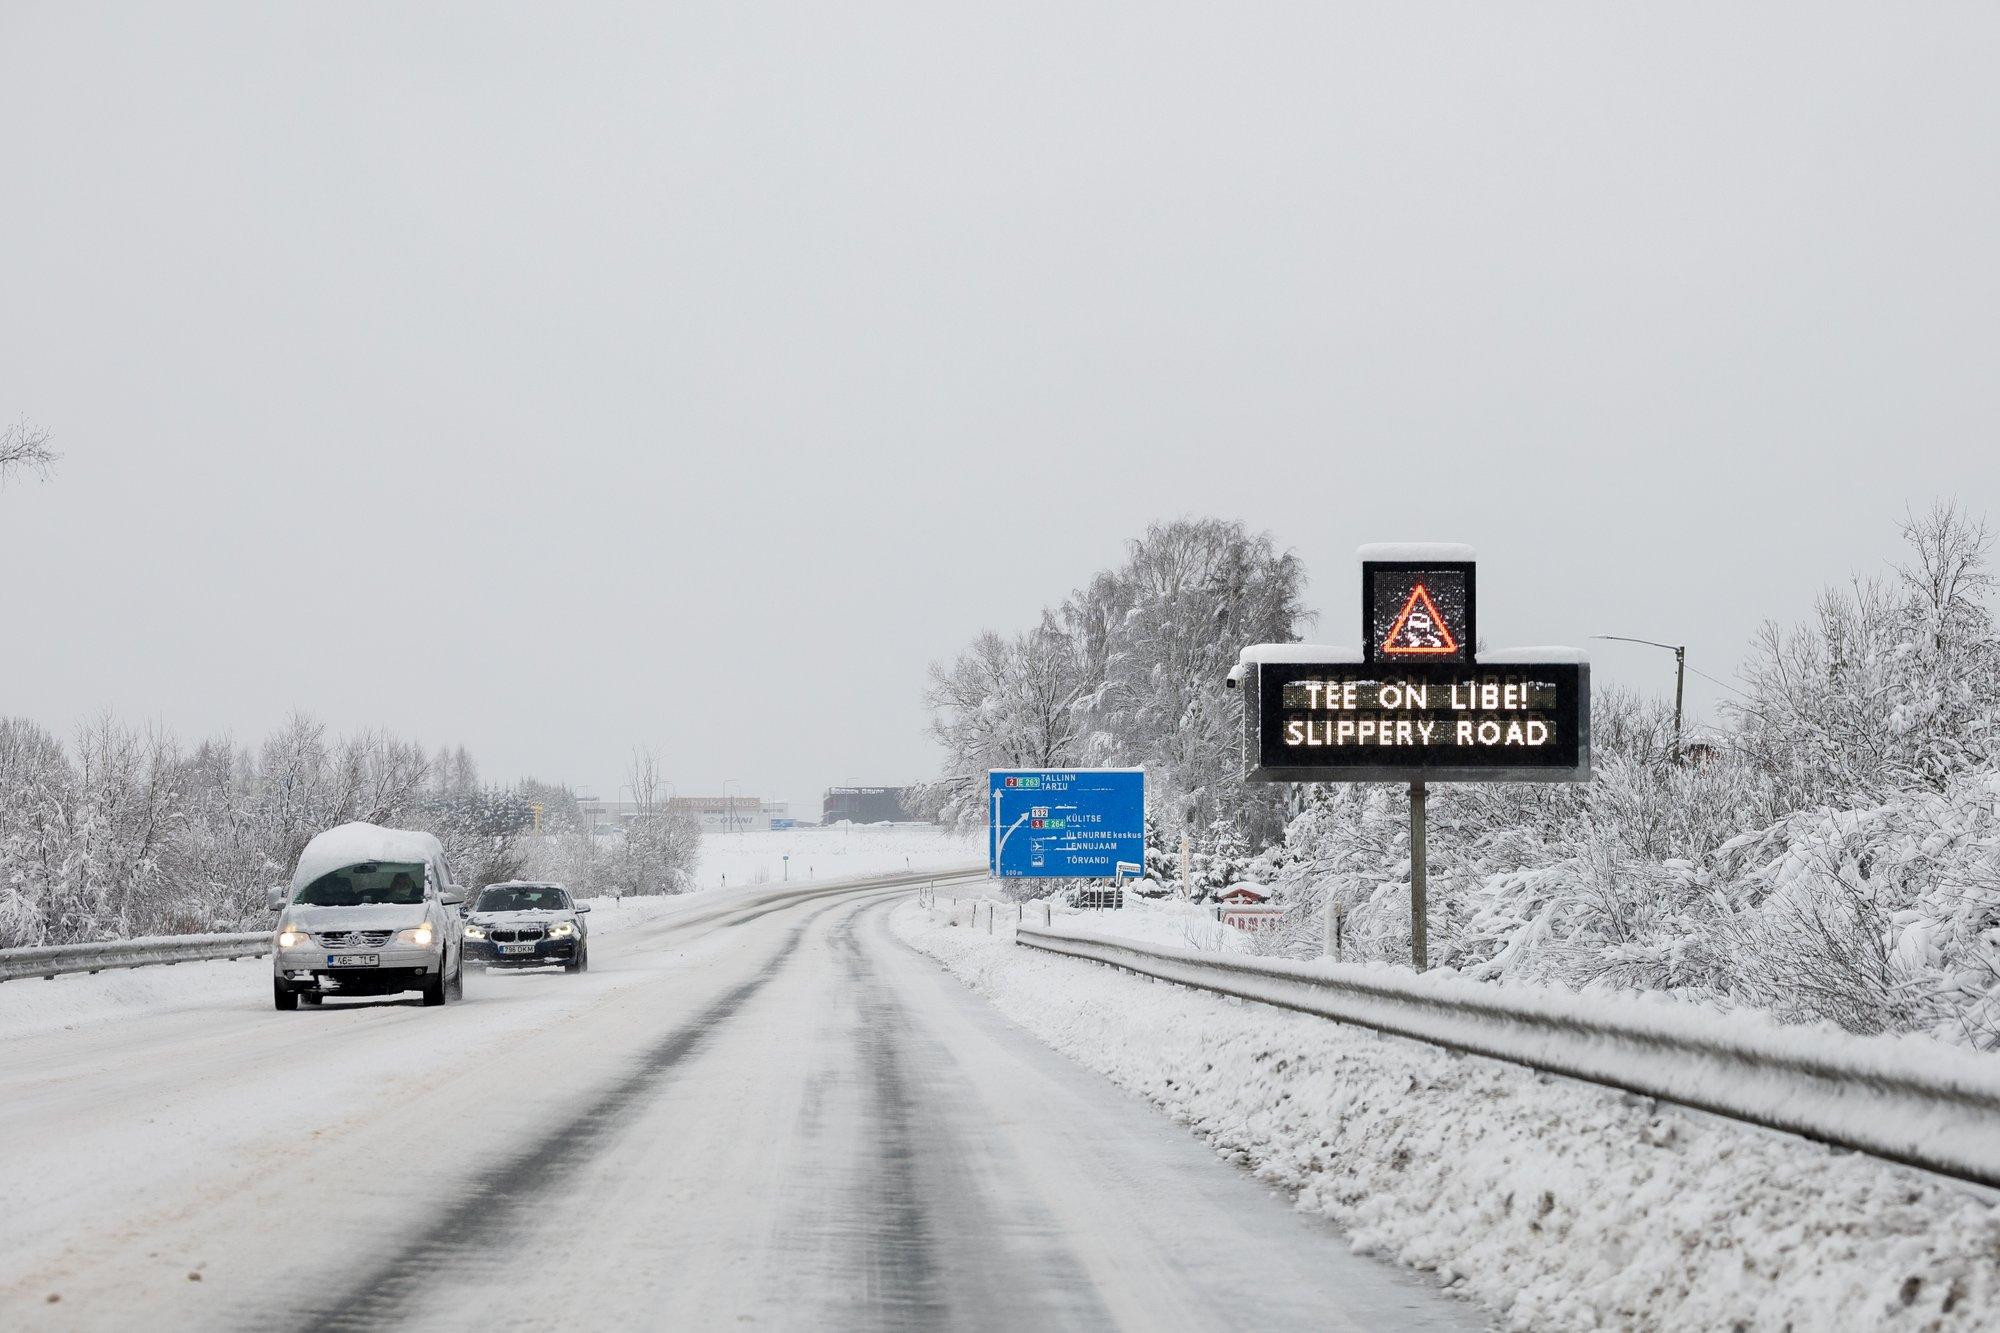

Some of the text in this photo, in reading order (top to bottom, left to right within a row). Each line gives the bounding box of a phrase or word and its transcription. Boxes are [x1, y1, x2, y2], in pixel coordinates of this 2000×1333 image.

[1306, 685, 1527, 710] TEE ON LIBE!
[1286, 720, 1549, 746] SLIPPERY ROAD
[1041, 774, 1076, 782] TALLINN
[1041, 782, 1068, 790] TARTU
[1033, 809, 1047, 817] 132
[1066, 814, 1102, 823] KÜLITSE
[1066, 831, 1142, 839] ÜLENURME keskus
[1066, 842, 1117, 850] LENNUJAAM
[1067, 855, 1109, 864] TÕRVANDI
